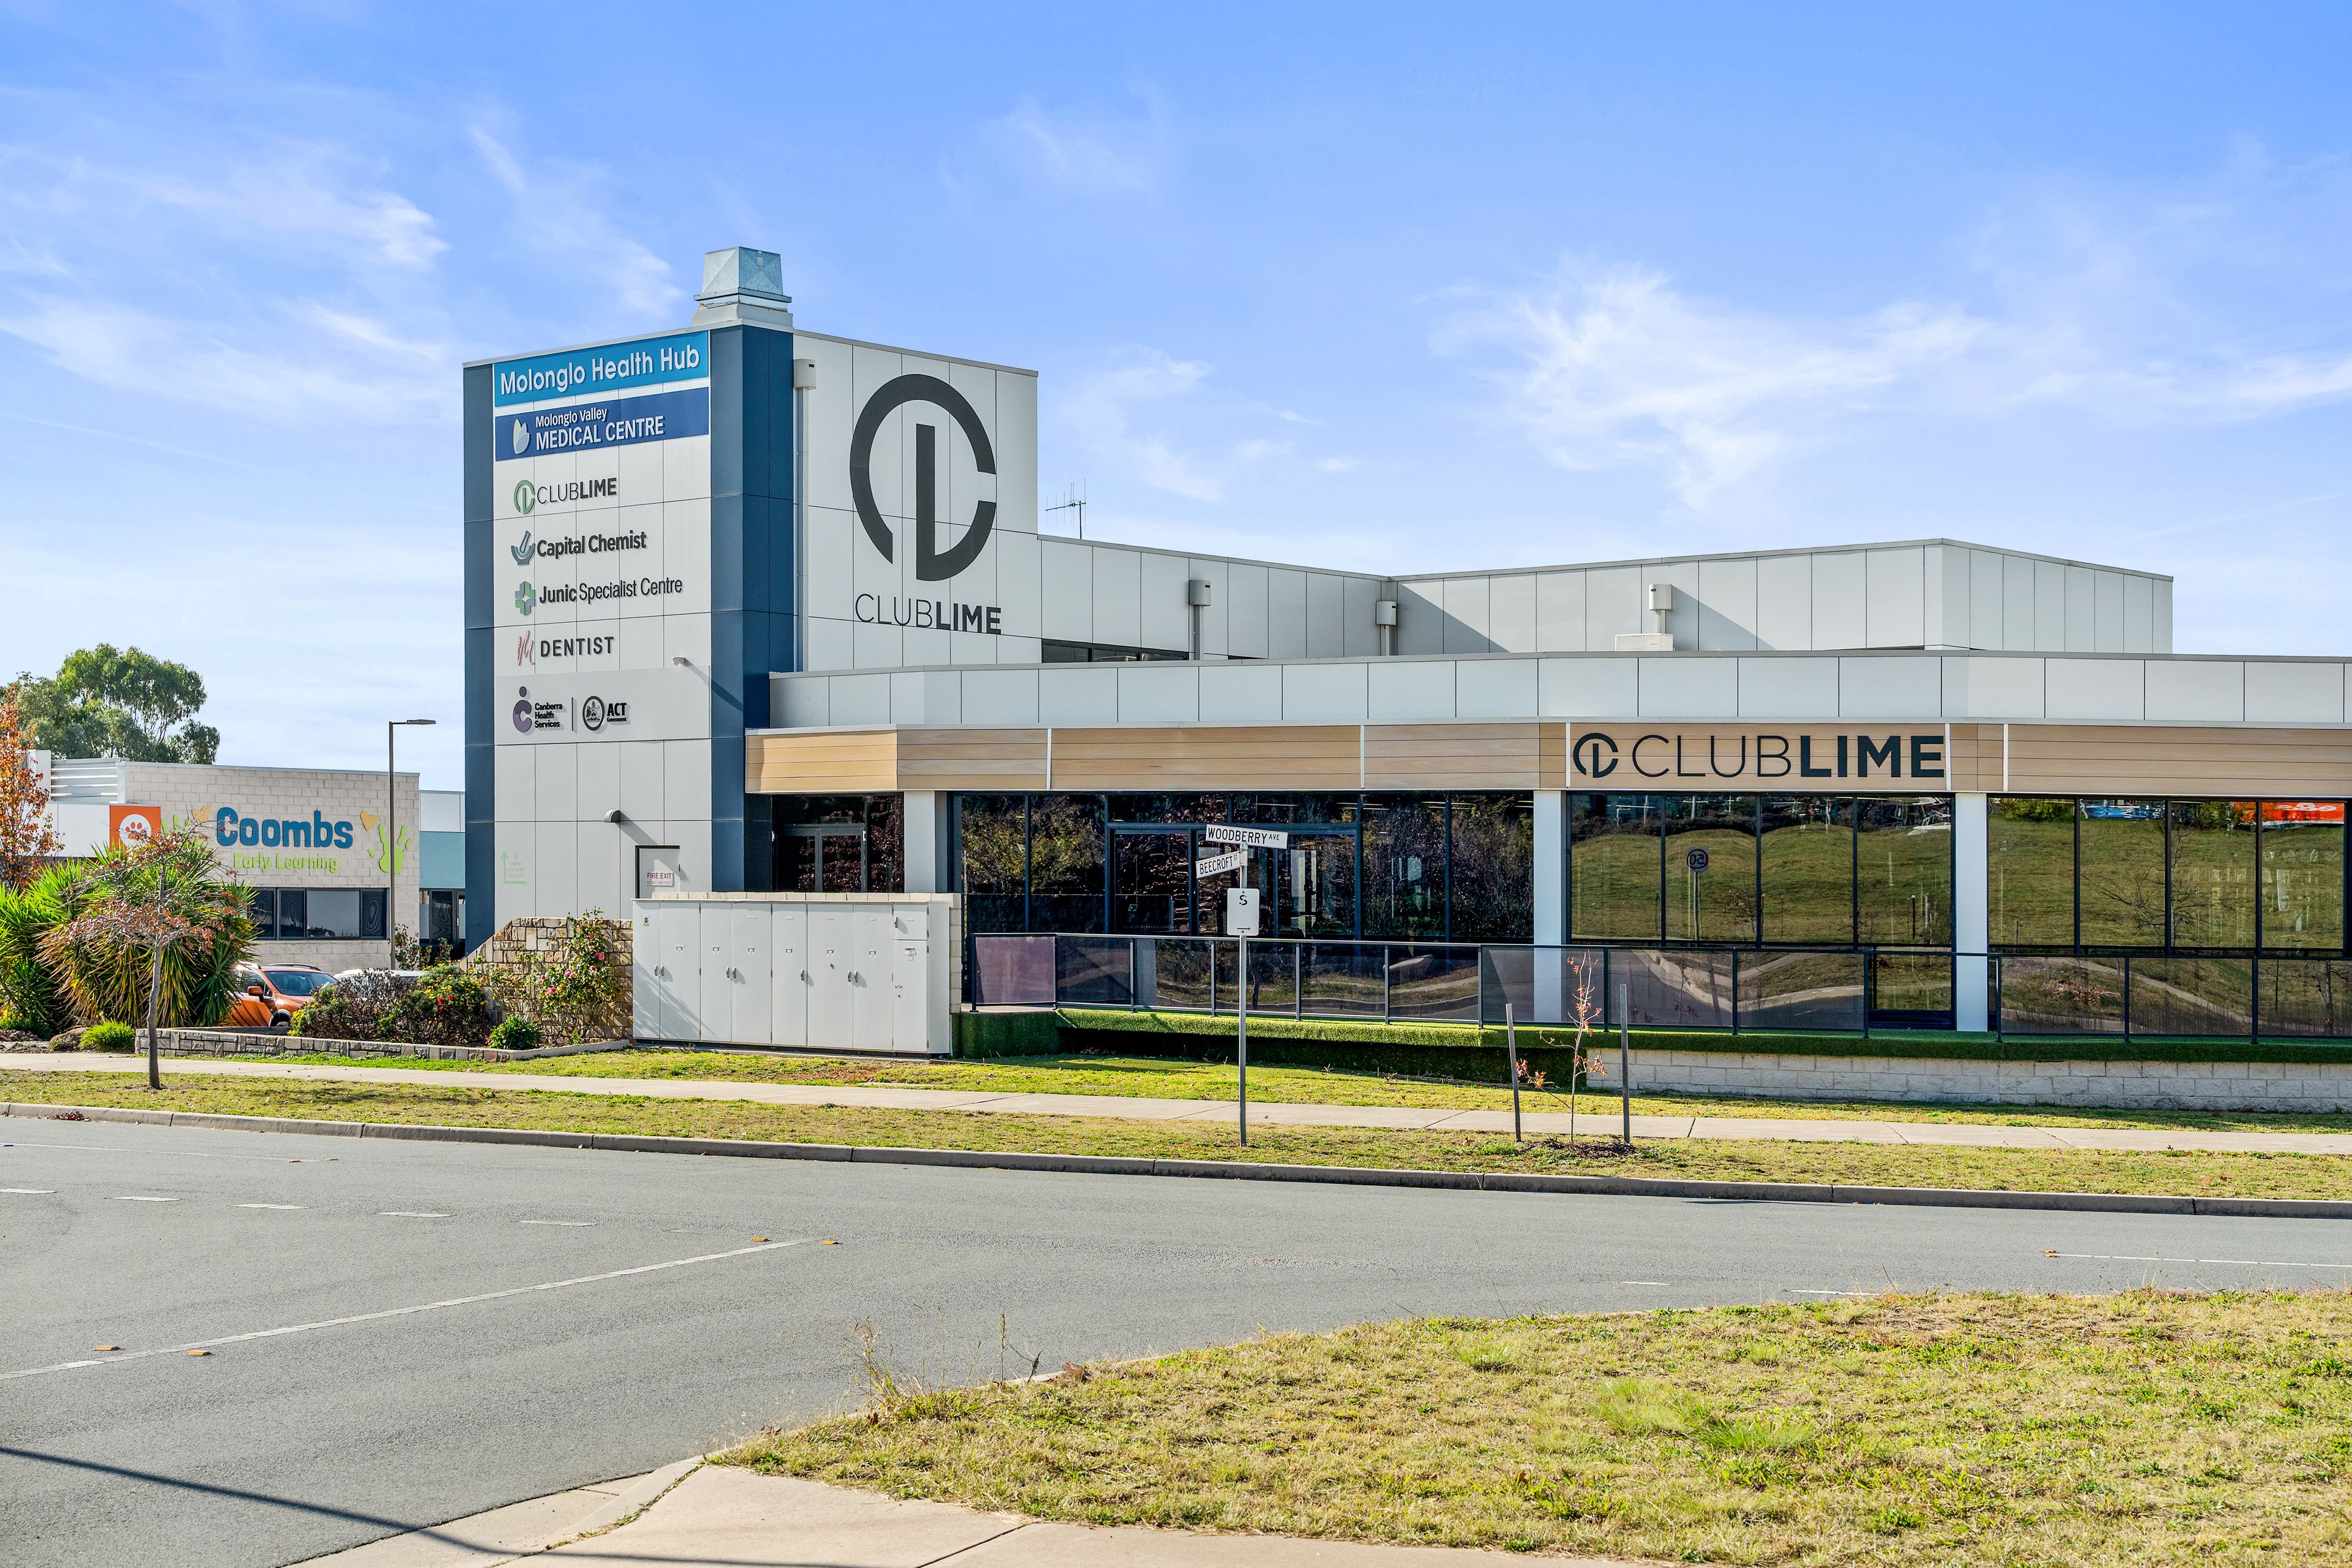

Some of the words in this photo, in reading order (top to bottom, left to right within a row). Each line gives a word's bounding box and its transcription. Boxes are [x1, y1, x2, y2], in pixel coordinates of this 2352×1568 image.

[500, 362, 586, 394] Molonglo
[592, 352, 653, 382] Health
[661, 345, 700, 371] Hub
[535, 410, 578, 428] Molonglo
[579, 408, 608, 422] Valley
[536, 426, 601, 450] MEDICAL
[605, 415, 665, 441] CENTRE
[537, 478, 617, 504] CLUBLIME
[537, 536, 586, 559] Capital
[588, 530, 646, 552] Chemist
[539, 584, 577, 603] Junic
[579, 580, 636, 604] Specialist
[641, 577, 682, 596] Centre
[855, 593, 1001, 635] CLUBLIME
[541, 636, 614, 657] DENTIST
[535, 702, 563, 710] Canberra
[535, 710, 554, 719] Health
[607, 703, 627, 717] ACT
[535, 720, 560, 728] Services
[1632, 734, 1945, 778] CLUBLIME
[217, 807, 353, 848] Coombs
[1208, 827, 1267, 844] WOODBERRY
[234, 852, 271, 872] Early
[276, 852, 337, 873] Learning
[1199, 856, 1234, 875] BEECROFT
